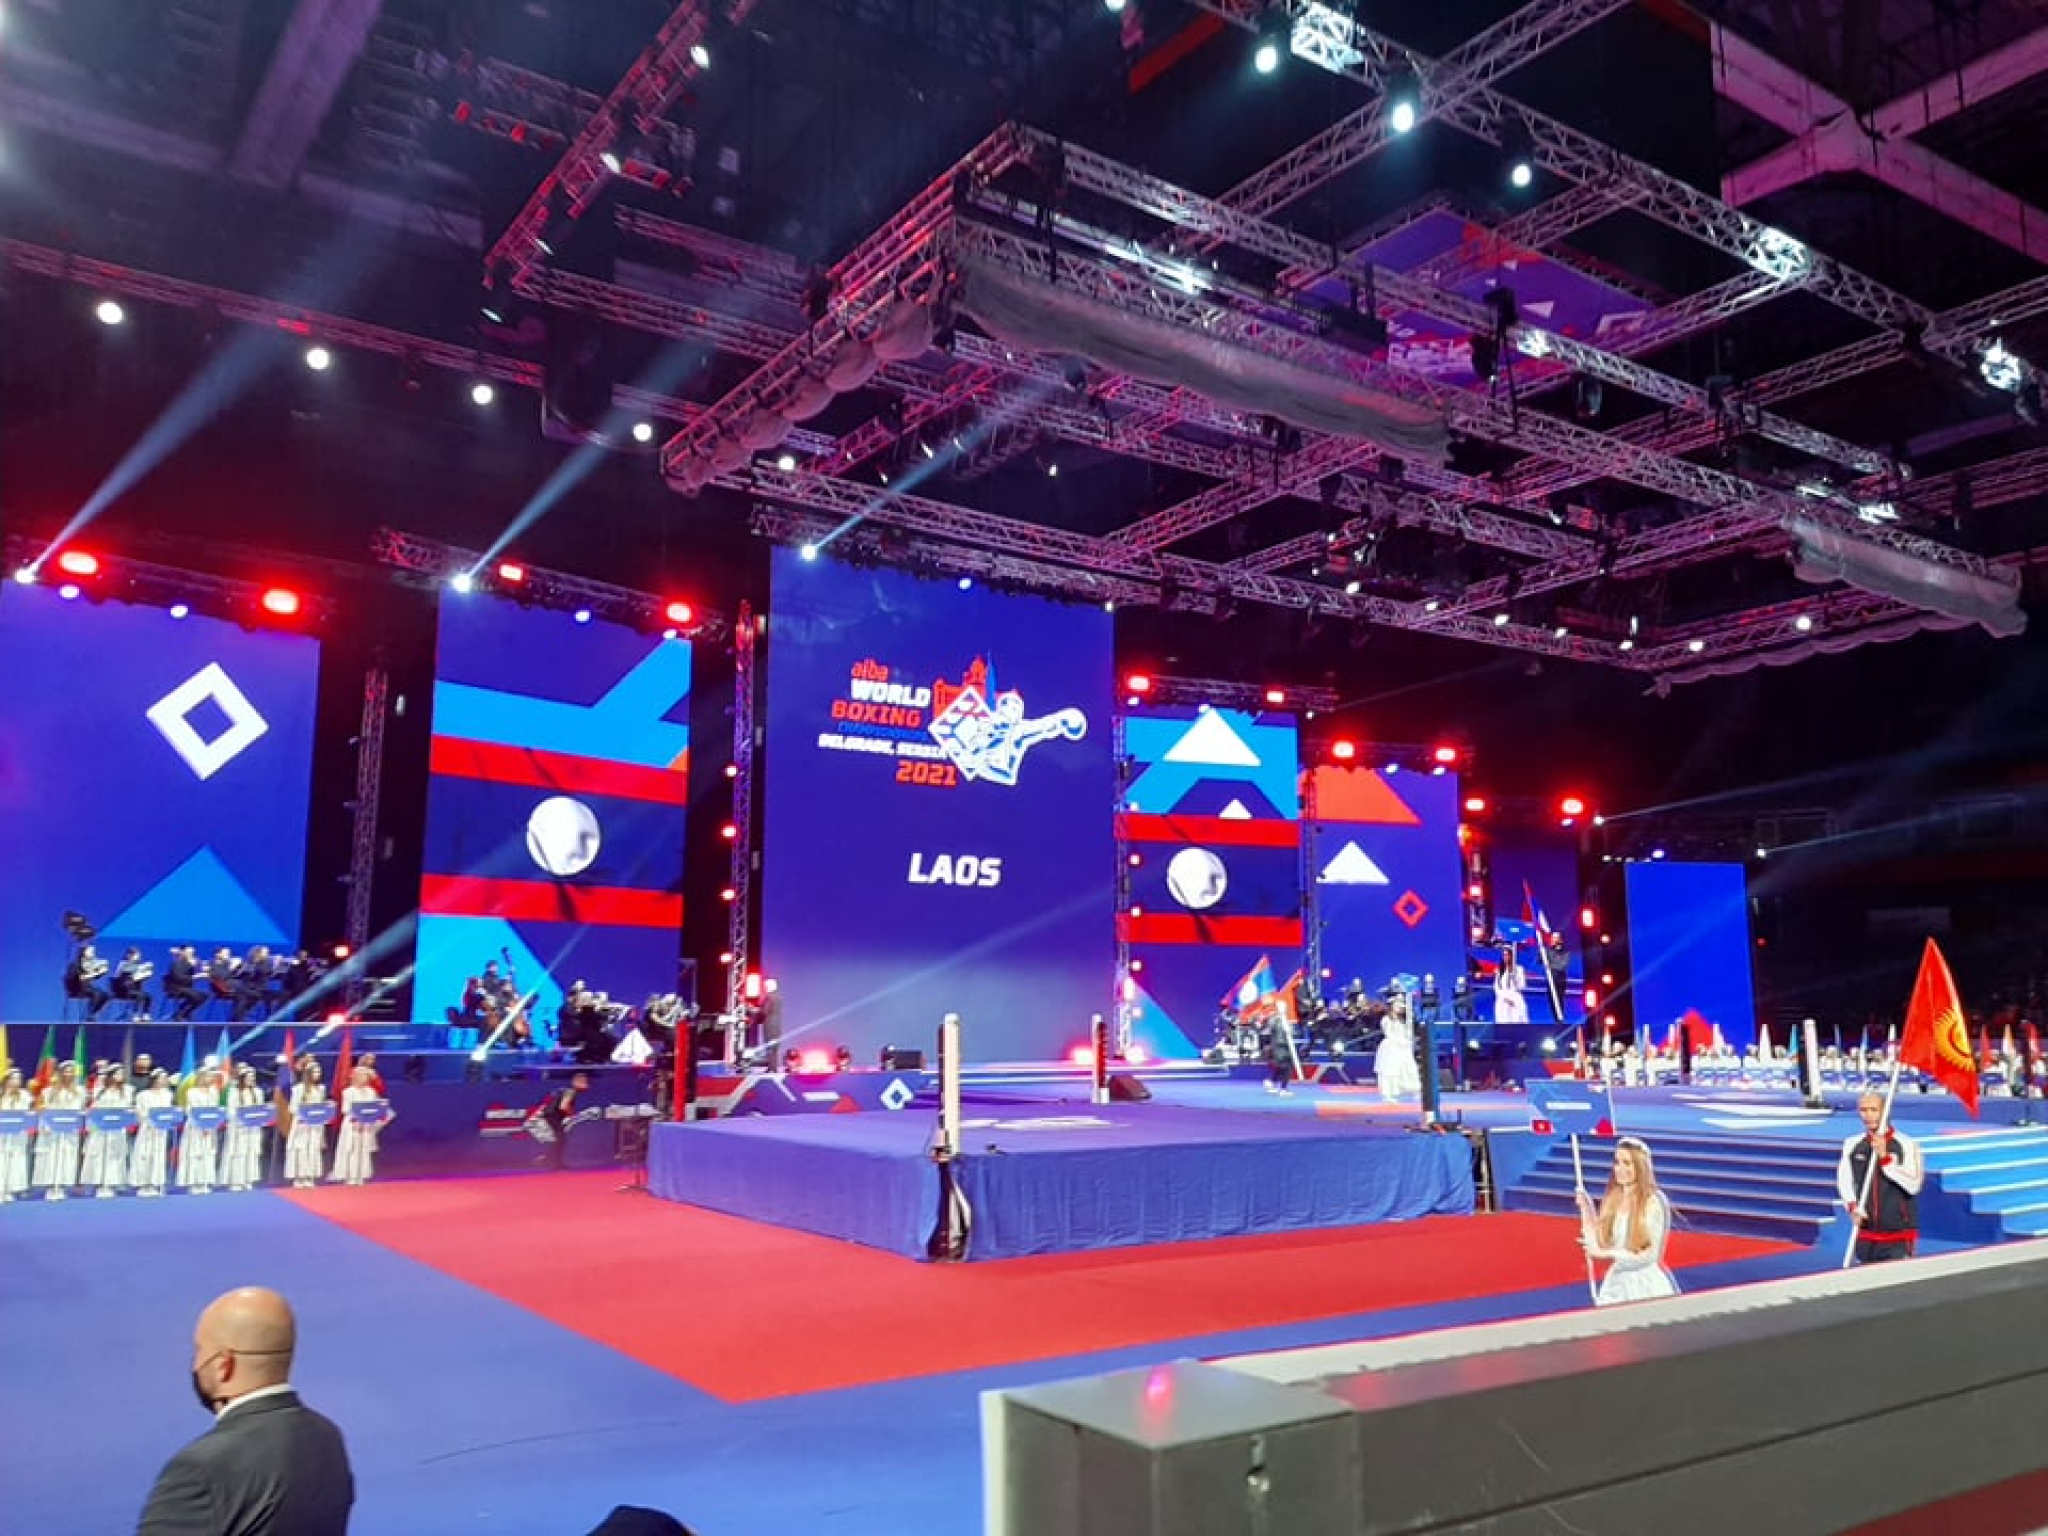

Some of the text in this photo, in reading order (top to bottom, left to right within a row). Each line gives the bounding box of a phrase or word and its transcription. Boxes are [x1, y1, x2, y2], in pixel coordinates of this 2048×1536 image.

[851, 678, 930, 708] WORLD
[832, 699, 921, 727] BOXING
[896, 759, 957, 786] 2021
[908, 853, 1001, 887] LAOS
